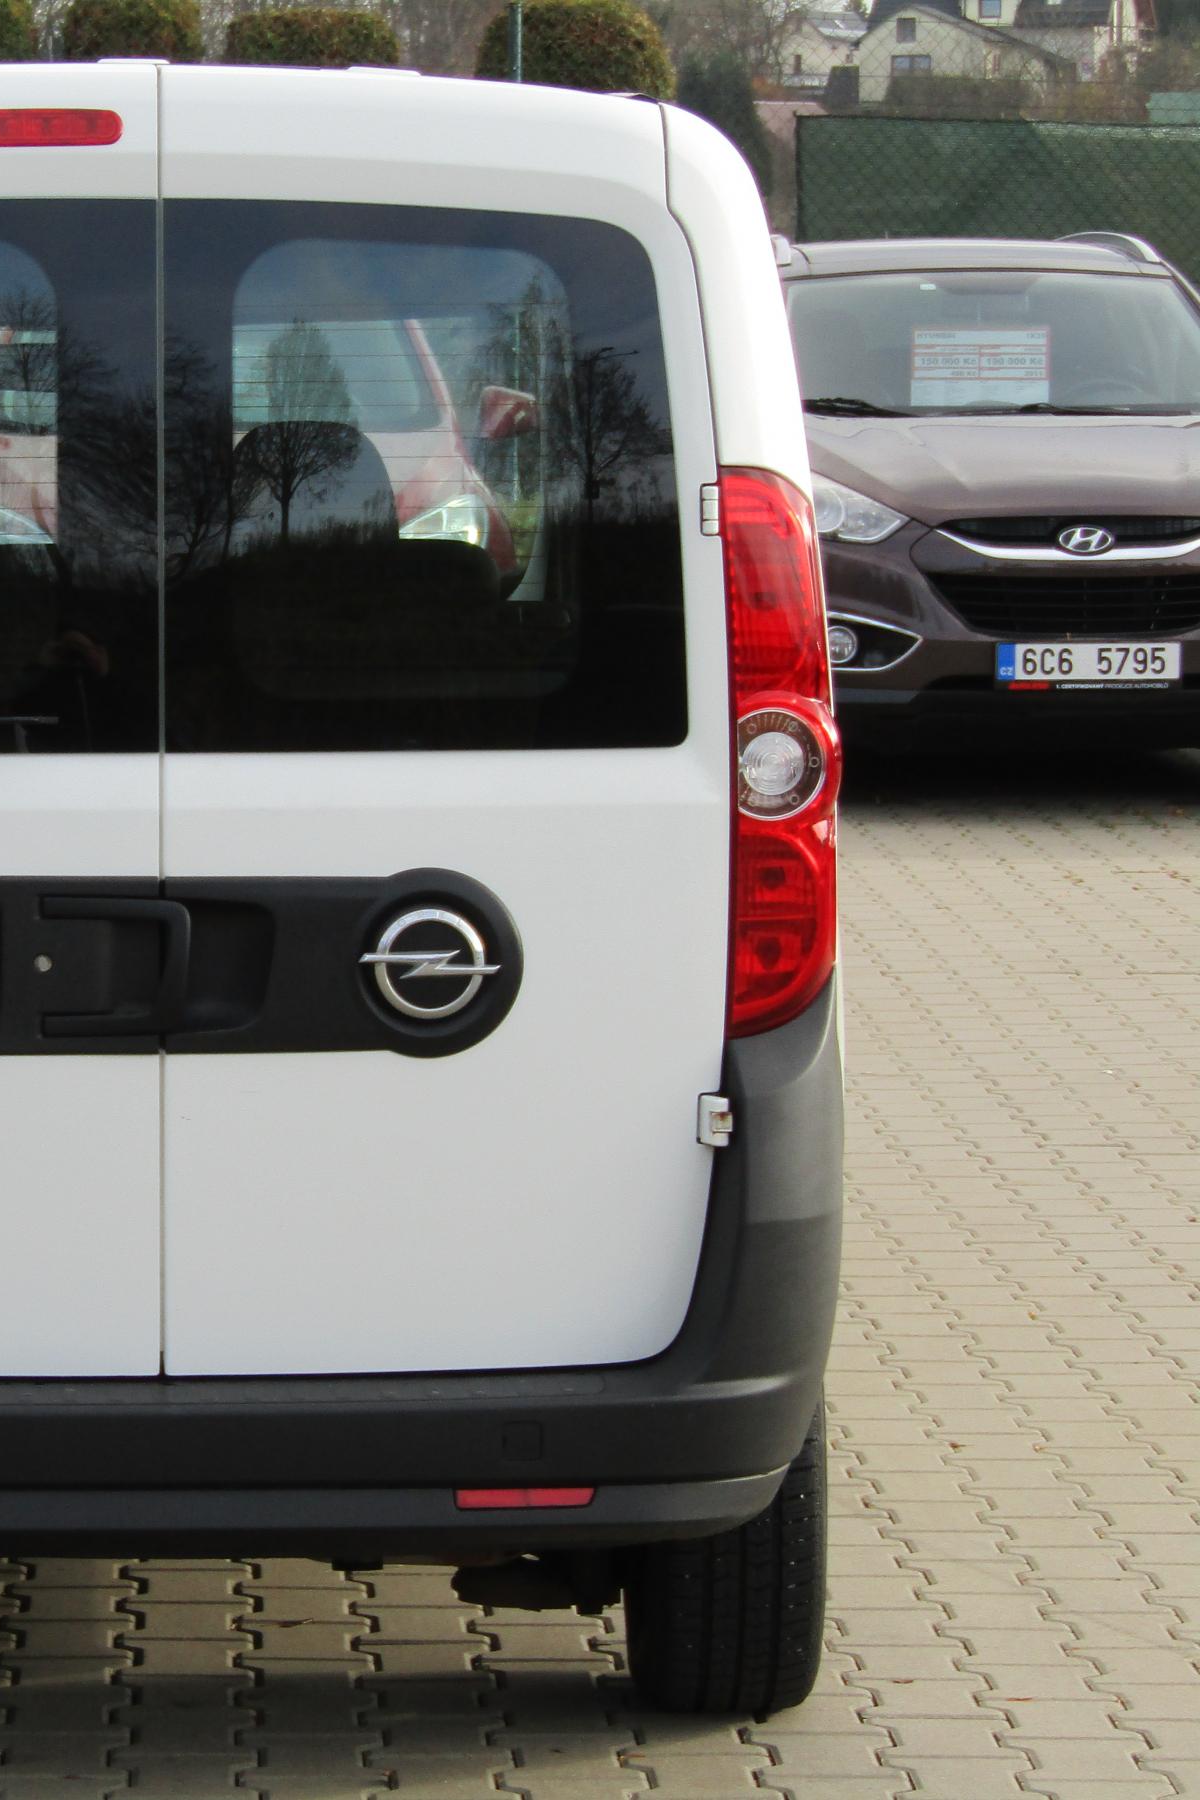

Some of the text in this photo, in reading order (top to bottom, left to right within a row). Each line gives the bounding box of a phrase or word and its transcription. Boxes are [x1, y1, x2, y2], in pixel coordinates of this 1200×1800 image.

[1000, 647, 1166, 676] CZ 6C6 5795
